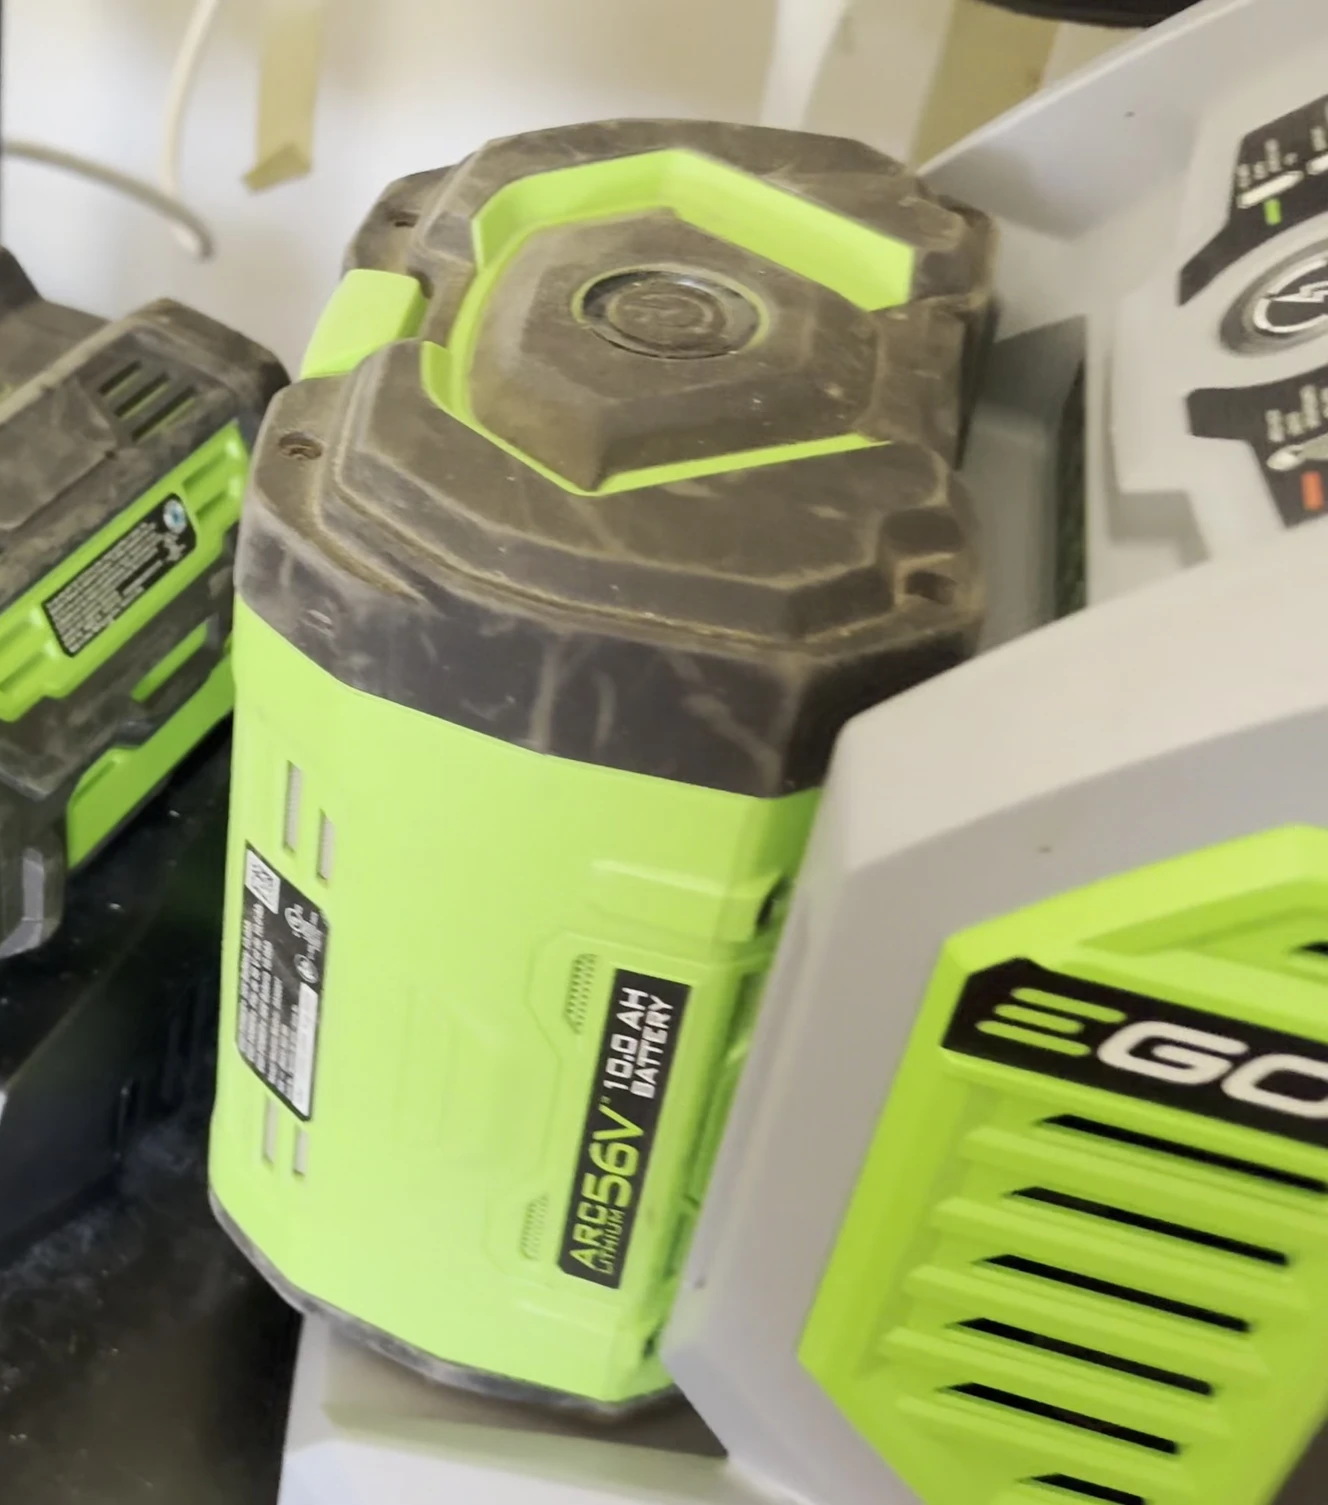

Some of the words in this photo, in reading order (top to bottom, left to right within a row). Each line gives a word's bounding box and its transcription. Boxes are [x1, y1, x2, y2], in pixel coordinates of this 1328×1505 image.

[615, 987, 649, 1034] AH
[603, 1034, 637, 1091] 10.0
[629, 995, 674, 1099] BATTERY
[974, 986, 1328, 1120] EGO
[582, 1105, 645, 1208] 56V
[569, 1201, 607, 1272] ARC
[593, 1209, 627, 1276] LITHIUM
